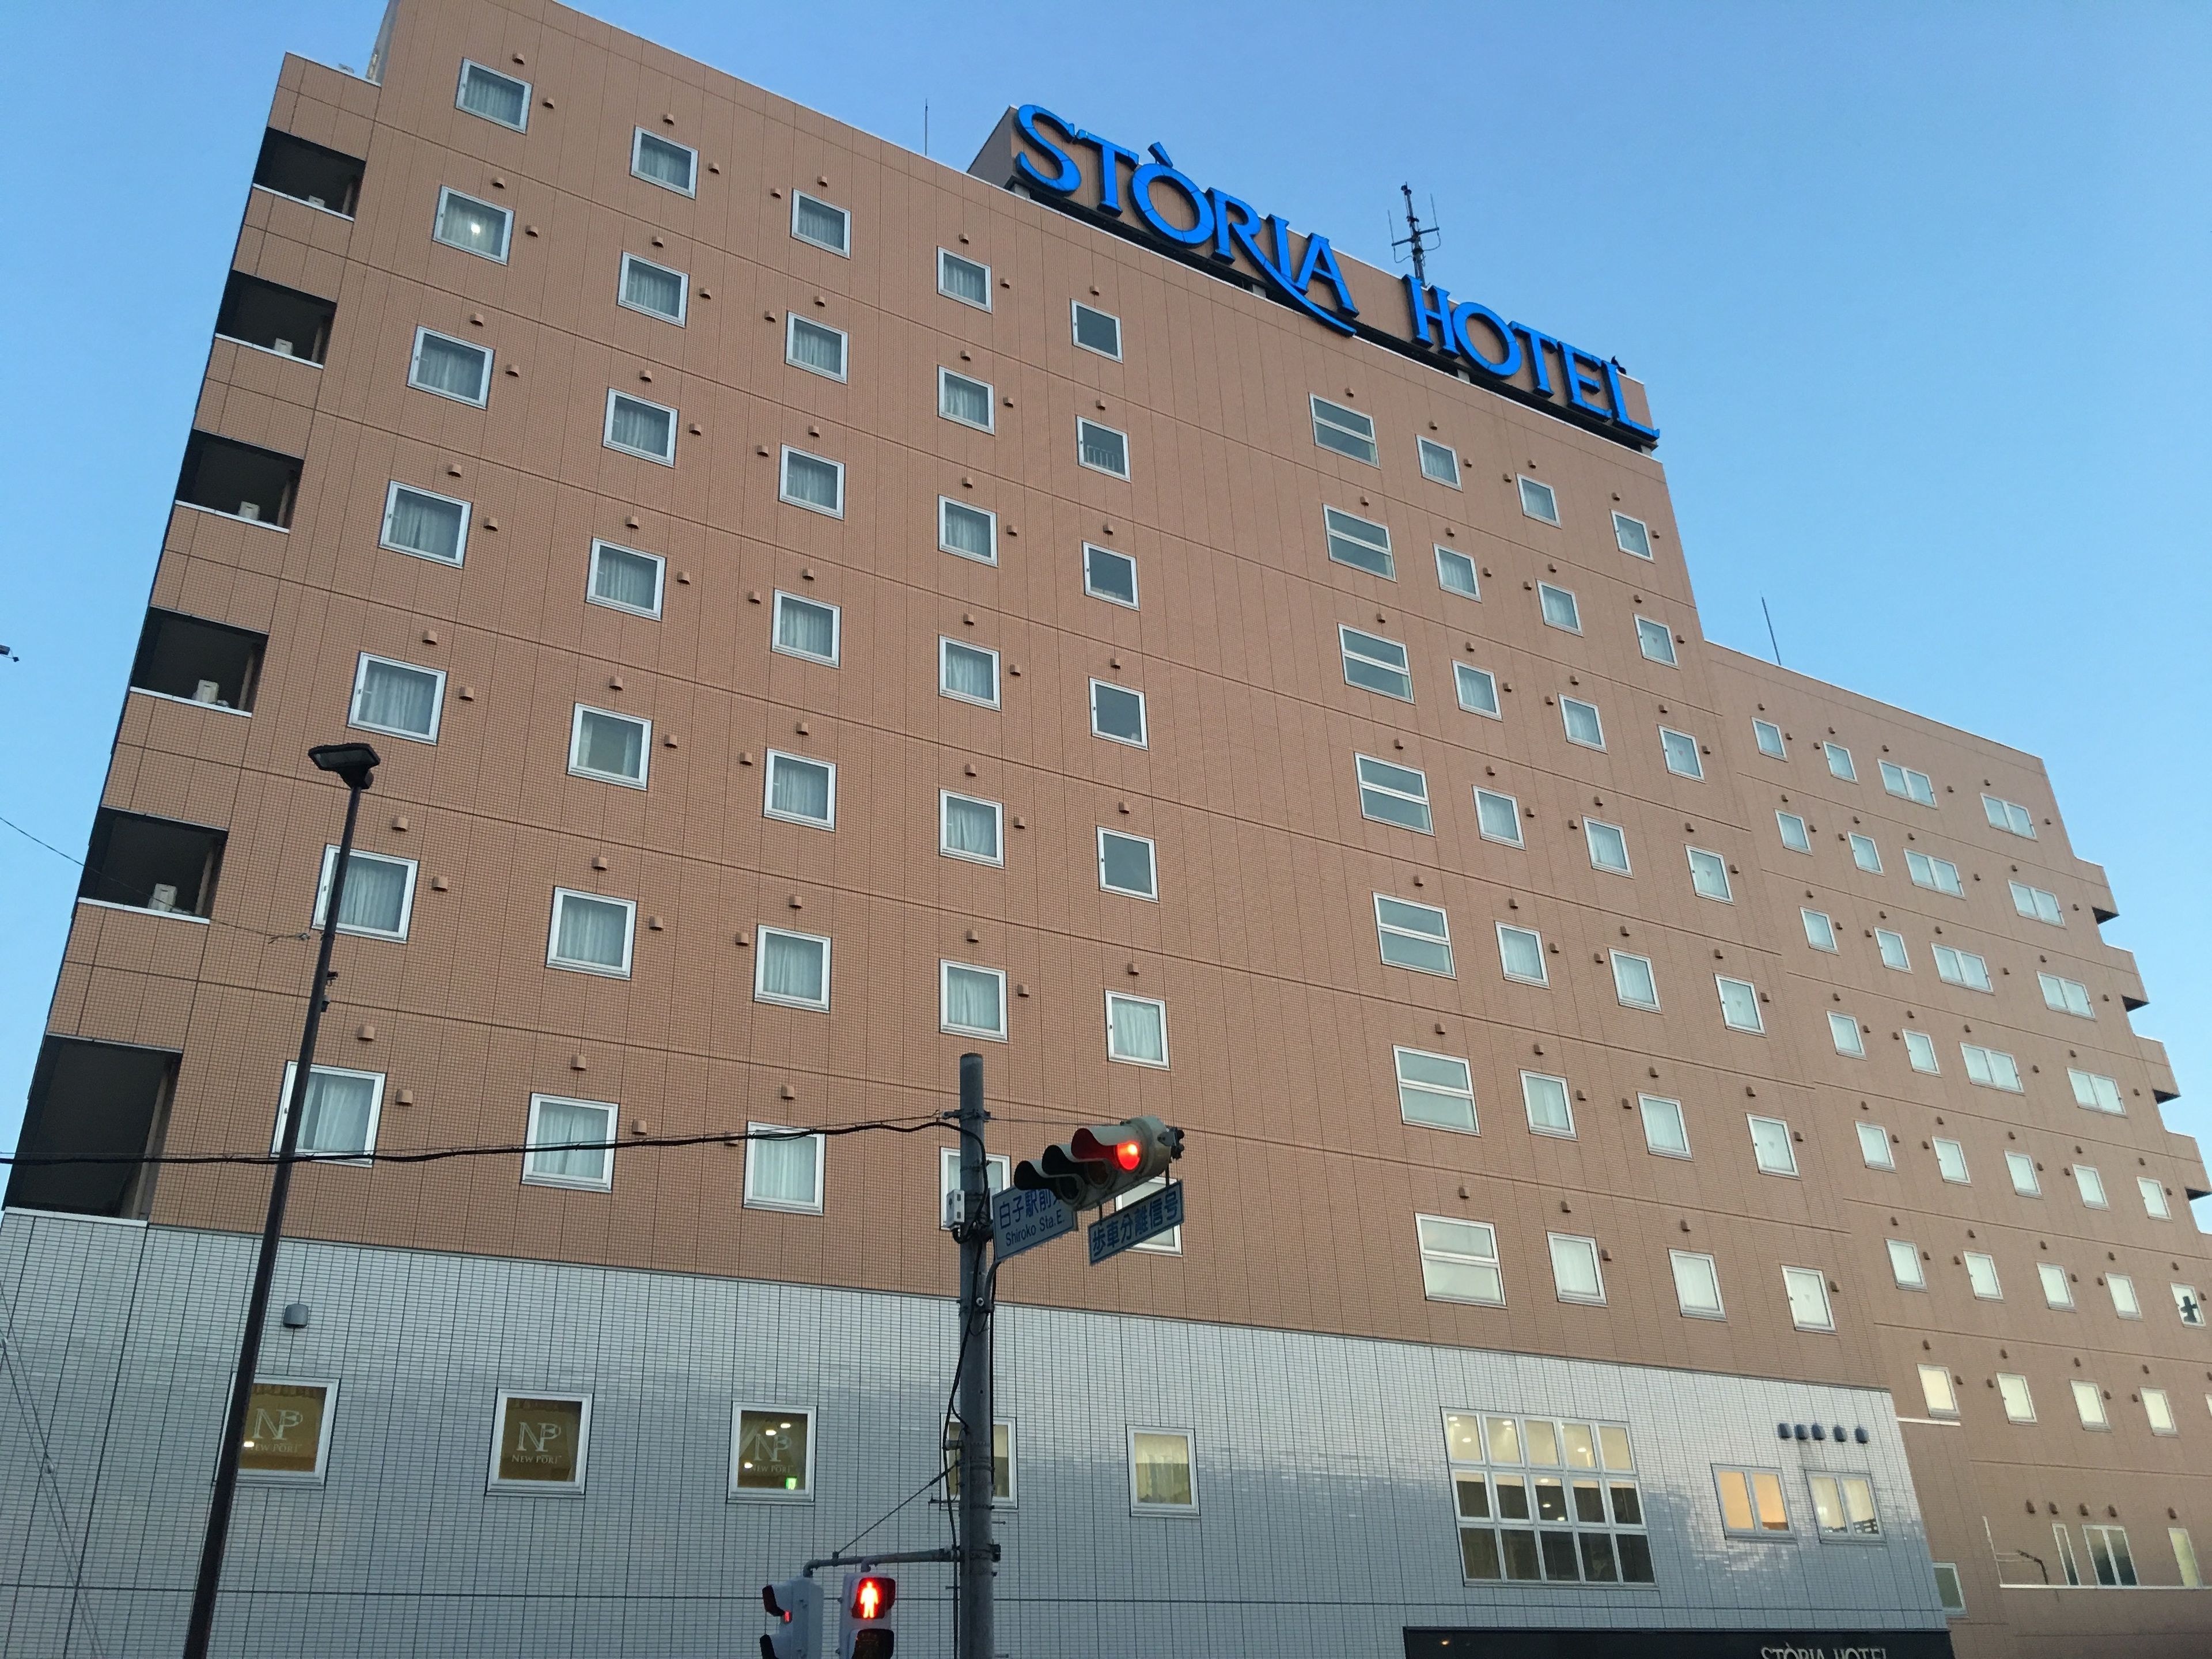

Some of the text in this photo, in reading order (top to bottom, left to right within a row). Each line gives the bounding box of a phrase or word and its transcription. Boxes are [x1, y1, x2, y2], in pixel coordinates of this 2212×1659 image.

[1013, 104, 1660, 438] STÒRIA HOTEL
[999, 1188, 1060, 1229] 白子駅前
[1093, 1190, 1179, 1257] 歩車分離信号
[1006, 1224, 1036, 1247] Shiroko
[252, 1408, 303, 1440] NP
[516, 1422, 562, 1452] NP
